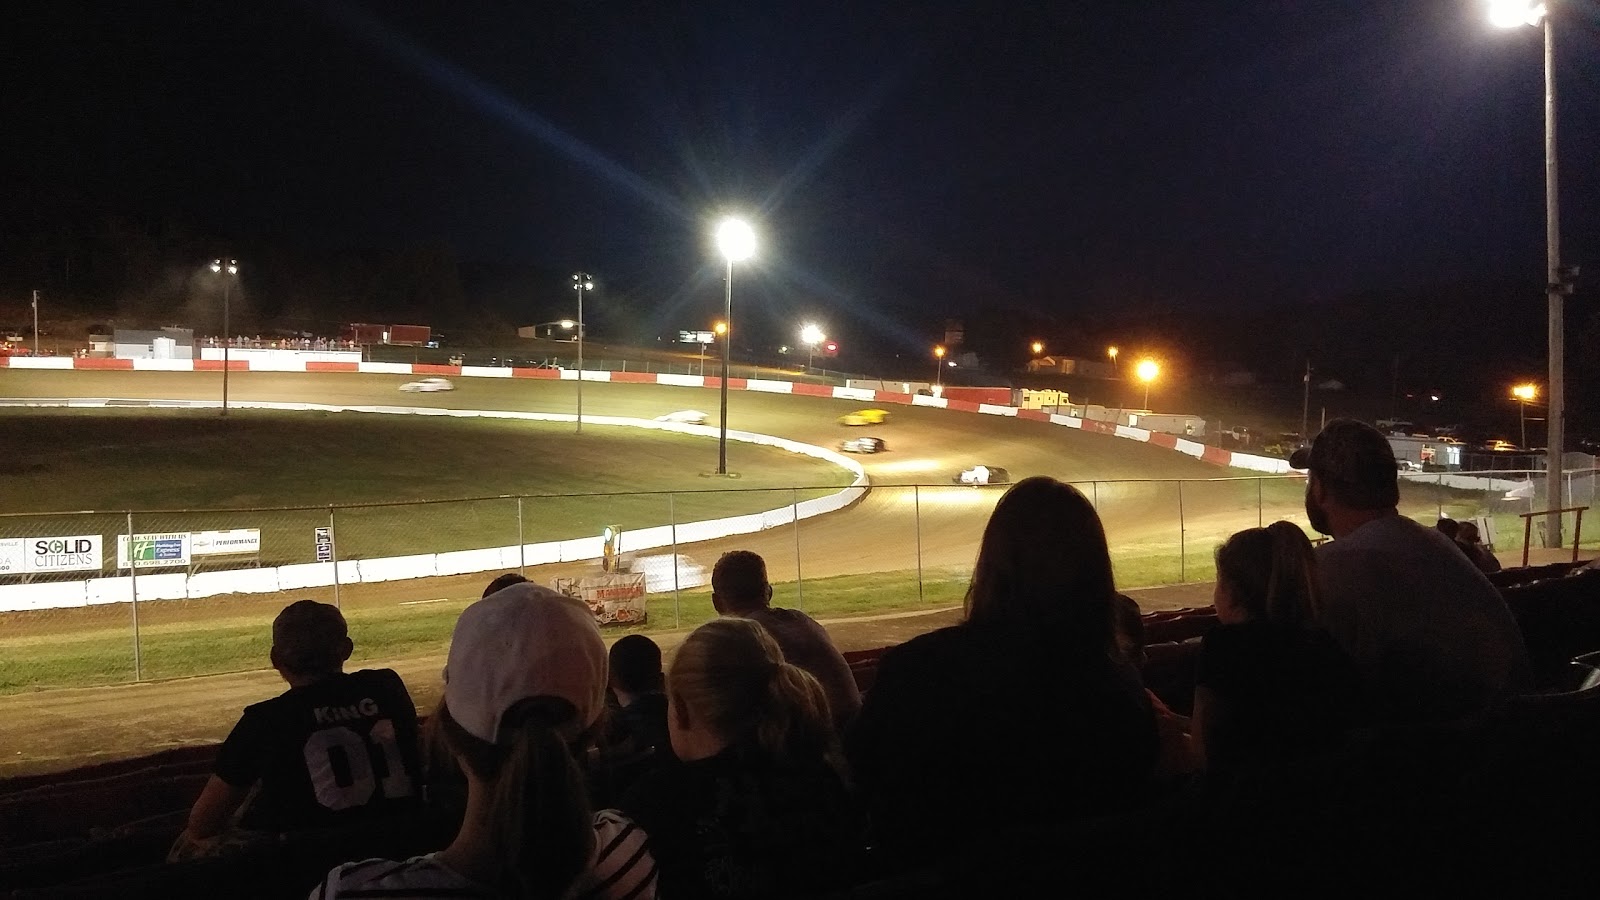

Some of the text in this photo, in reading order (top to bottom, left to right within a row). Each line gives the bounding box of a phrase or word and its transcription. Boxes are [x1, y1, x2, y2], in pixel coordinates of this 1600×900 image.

[35, 539, 92, 555] SOLID
[215, 538, 258, 546] PERFORMANCE
[34, 553, 93, 567] CITIZENS
[313, 697, 379, 723] KING
[303, 718, 414, 811] 01
